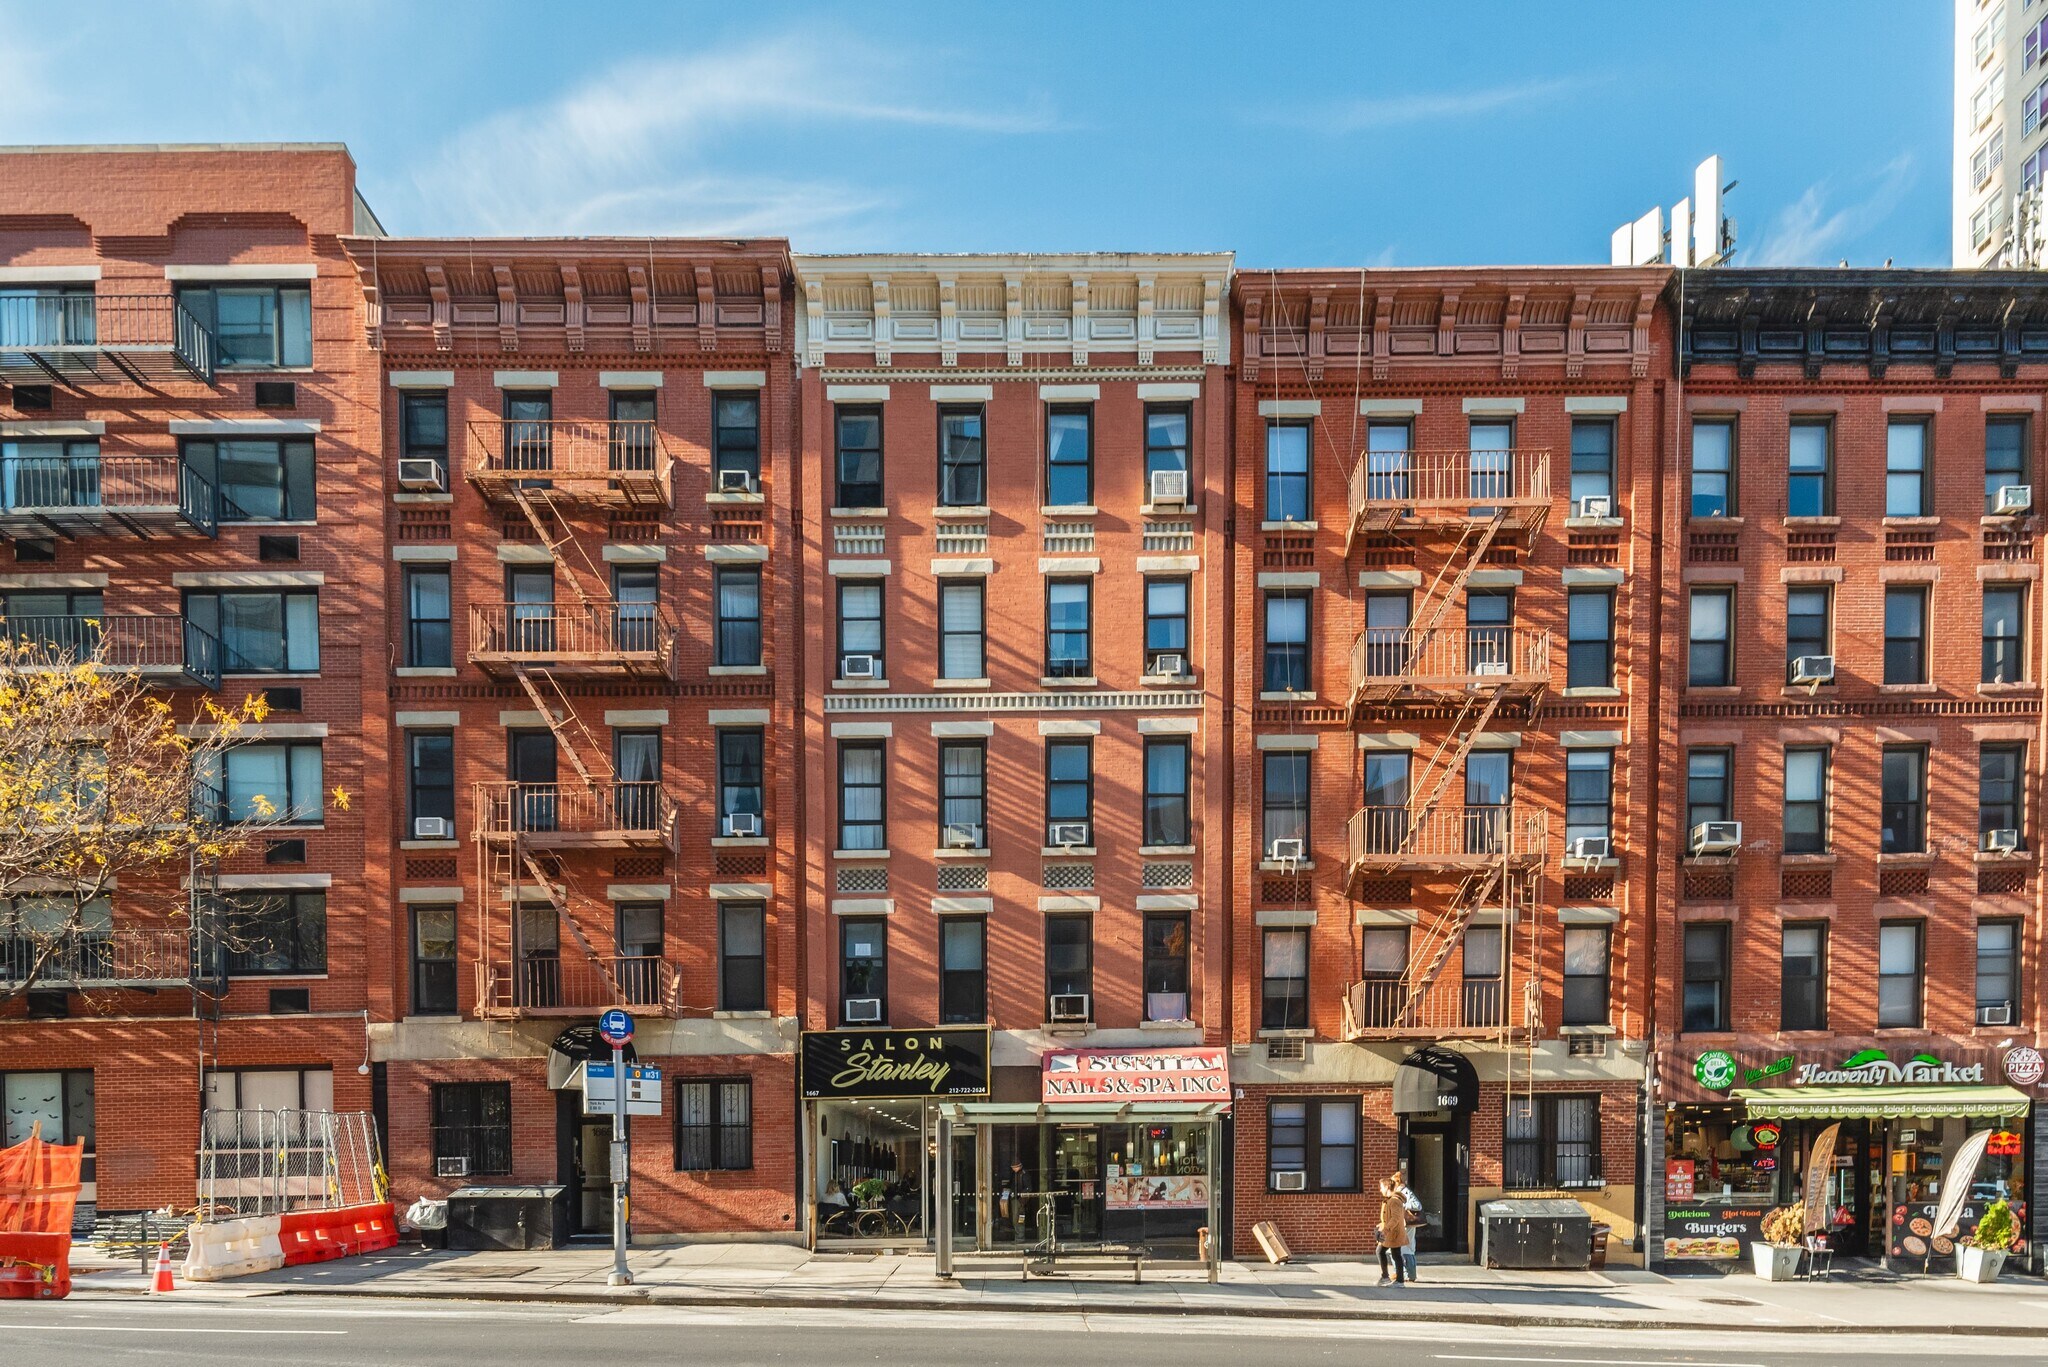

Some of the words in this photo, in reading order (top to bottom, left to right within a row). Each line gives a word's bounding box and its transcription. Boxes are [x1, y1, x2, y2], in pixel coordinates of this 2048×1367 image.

[841, 1037, 942, 1051] SALON
[1701, 1051, 1732, 1065] HEAVENLY
[831, 1052, 950, 1093] Stanley
[1796, 1063, 1887, 1086] Heavenly
[1887, 1060, 1984, 1083] Market
[2008, 1063, 2041, 1073] PIZZA
[645, 1070, 659, 1079] M31
[1116, 1076, 1132, 1093] &
[1133, 1076, 1176, 1094] SPA
[1181, 1077, 1227, 1094] INC.
[1701, 1077, 1731, 1088] MARKET
[1437, 1095, 1458, 1106] 1669
[1751, 1105, 1771, 1114] 1671
[1778, 1105, 1805, 1114] Coffee
[1808, 1105, 1829, 1114] Juice
[1831, 1105, 1836, 1114] &
[1838, 1105, 1878, 1114] Smoothies
[1884, 1104, 1906, 1113] Salad
[1911, 1104, 1957, 1113] Sandwiches
[1963, 1104, 1976, 1112] Hot
[1978, 1104, 1997, 1112] Food
[1987, 1144, 2003, 1155] Red
[2004, 1144, 2021, 1155] Bull
[1668, 1210, 1710, 1220] Delicious
[1722, 1210, 1738, 1220] Hot
[1685, 1223, 1747, 1237] Burgers
